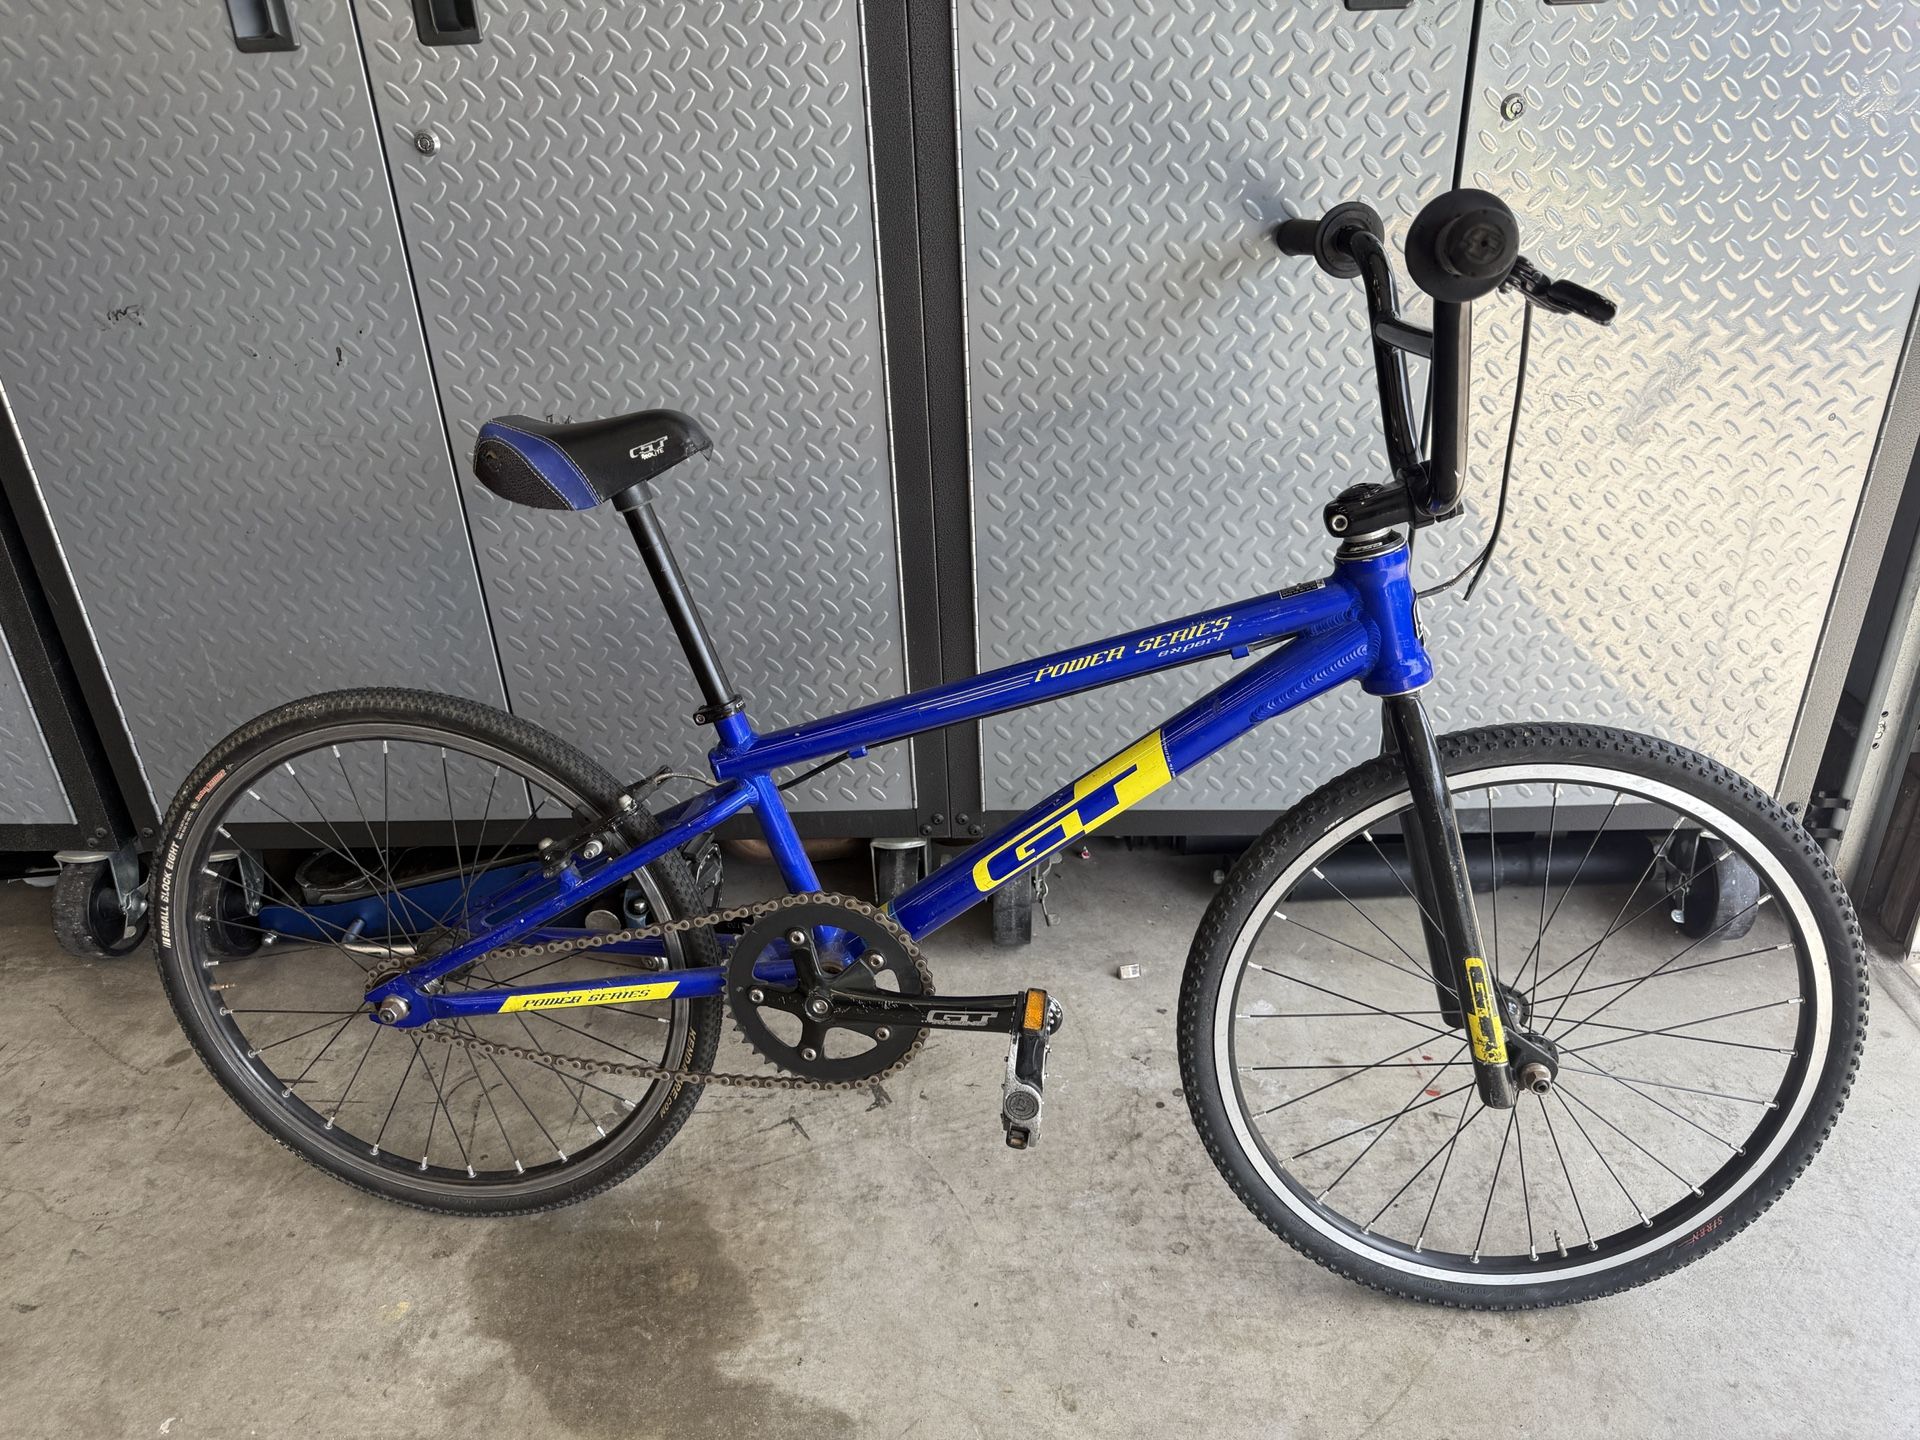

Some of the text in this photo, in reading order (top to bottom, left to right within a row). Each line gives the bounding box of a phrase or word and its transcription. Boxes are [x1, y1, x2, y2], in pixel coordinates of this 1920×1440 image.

[629, 435, 668, 458] GT
[1035, 616, 1233, 683] POWER SERIES
[1158, 632, 1226, 658] expert
[973, 729, 1171, 892] GT
[161, 841, 180, 938] SMALL BLOCK EIGHT
[522, 989, 651, 1008] POWER SERIES
[926, 1009, 999, 1026] GT
[1691, 1216, 1724, 1244] SIREN
